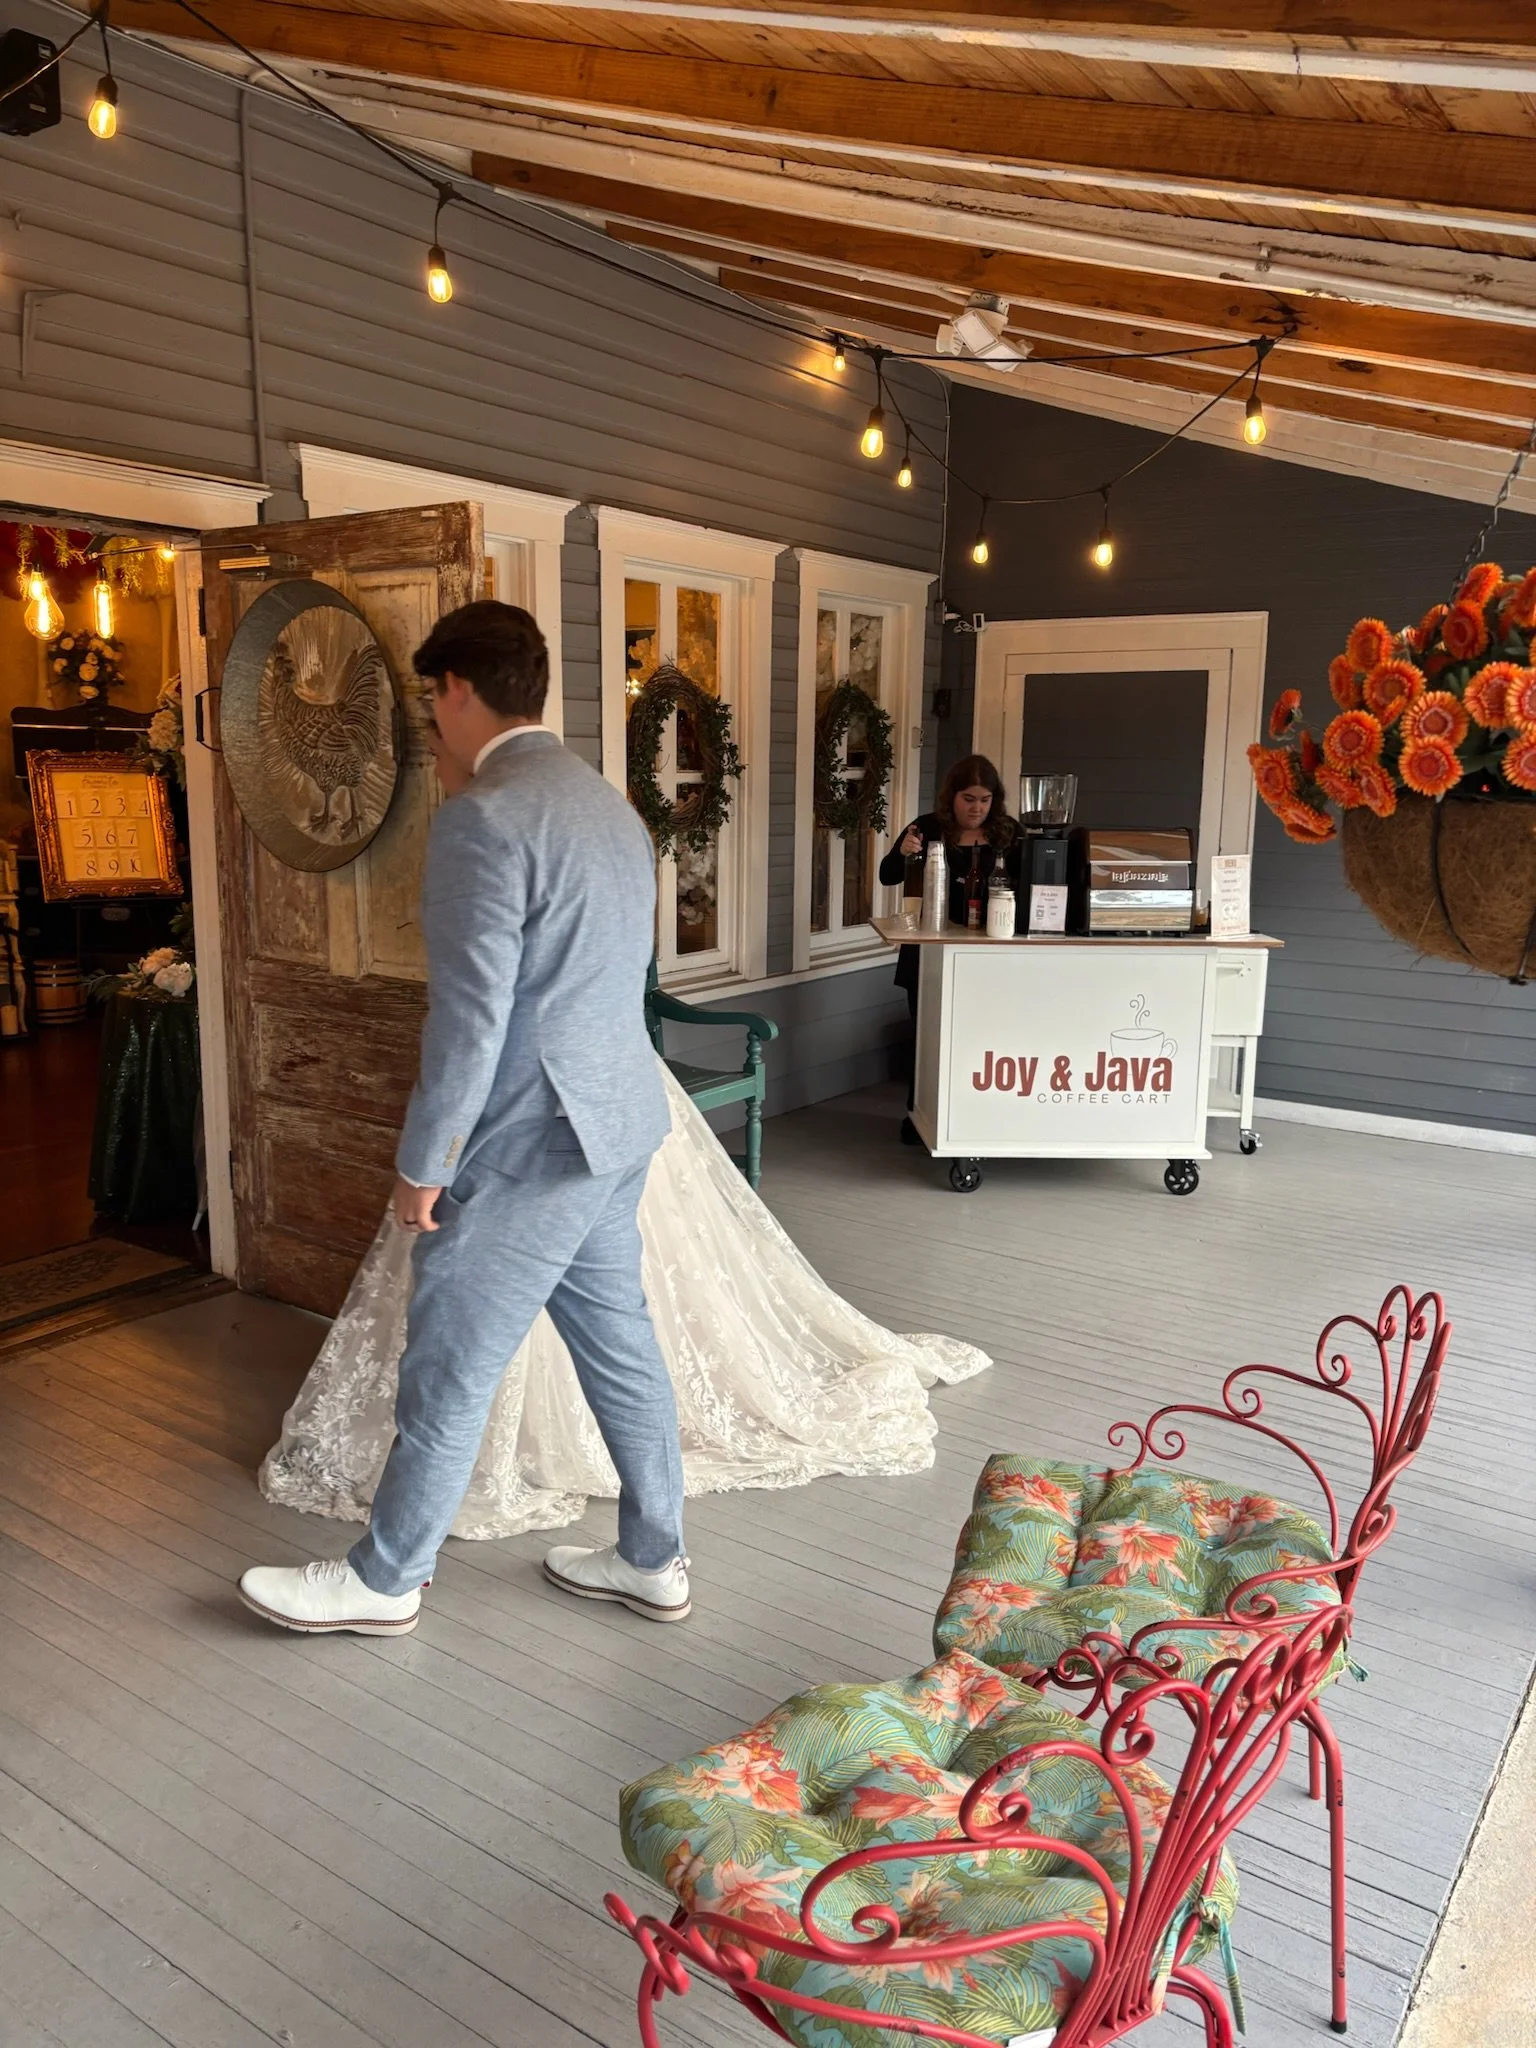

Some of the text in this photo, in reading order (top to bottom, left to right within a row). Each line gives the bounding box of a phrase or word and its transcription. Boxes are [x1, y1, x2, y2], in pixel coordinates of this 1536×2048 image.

[67, 797, 149, 816] 1 2 3 4
[81, 828, 137, 846] 5 6 7
[86, 859, 98, 876] 8
[108, 859, 120, 876] 9
[972, 1051, 1173, 1097] Joy & Java
[1037, 1093, 1171, 1104] COFFEE CART
